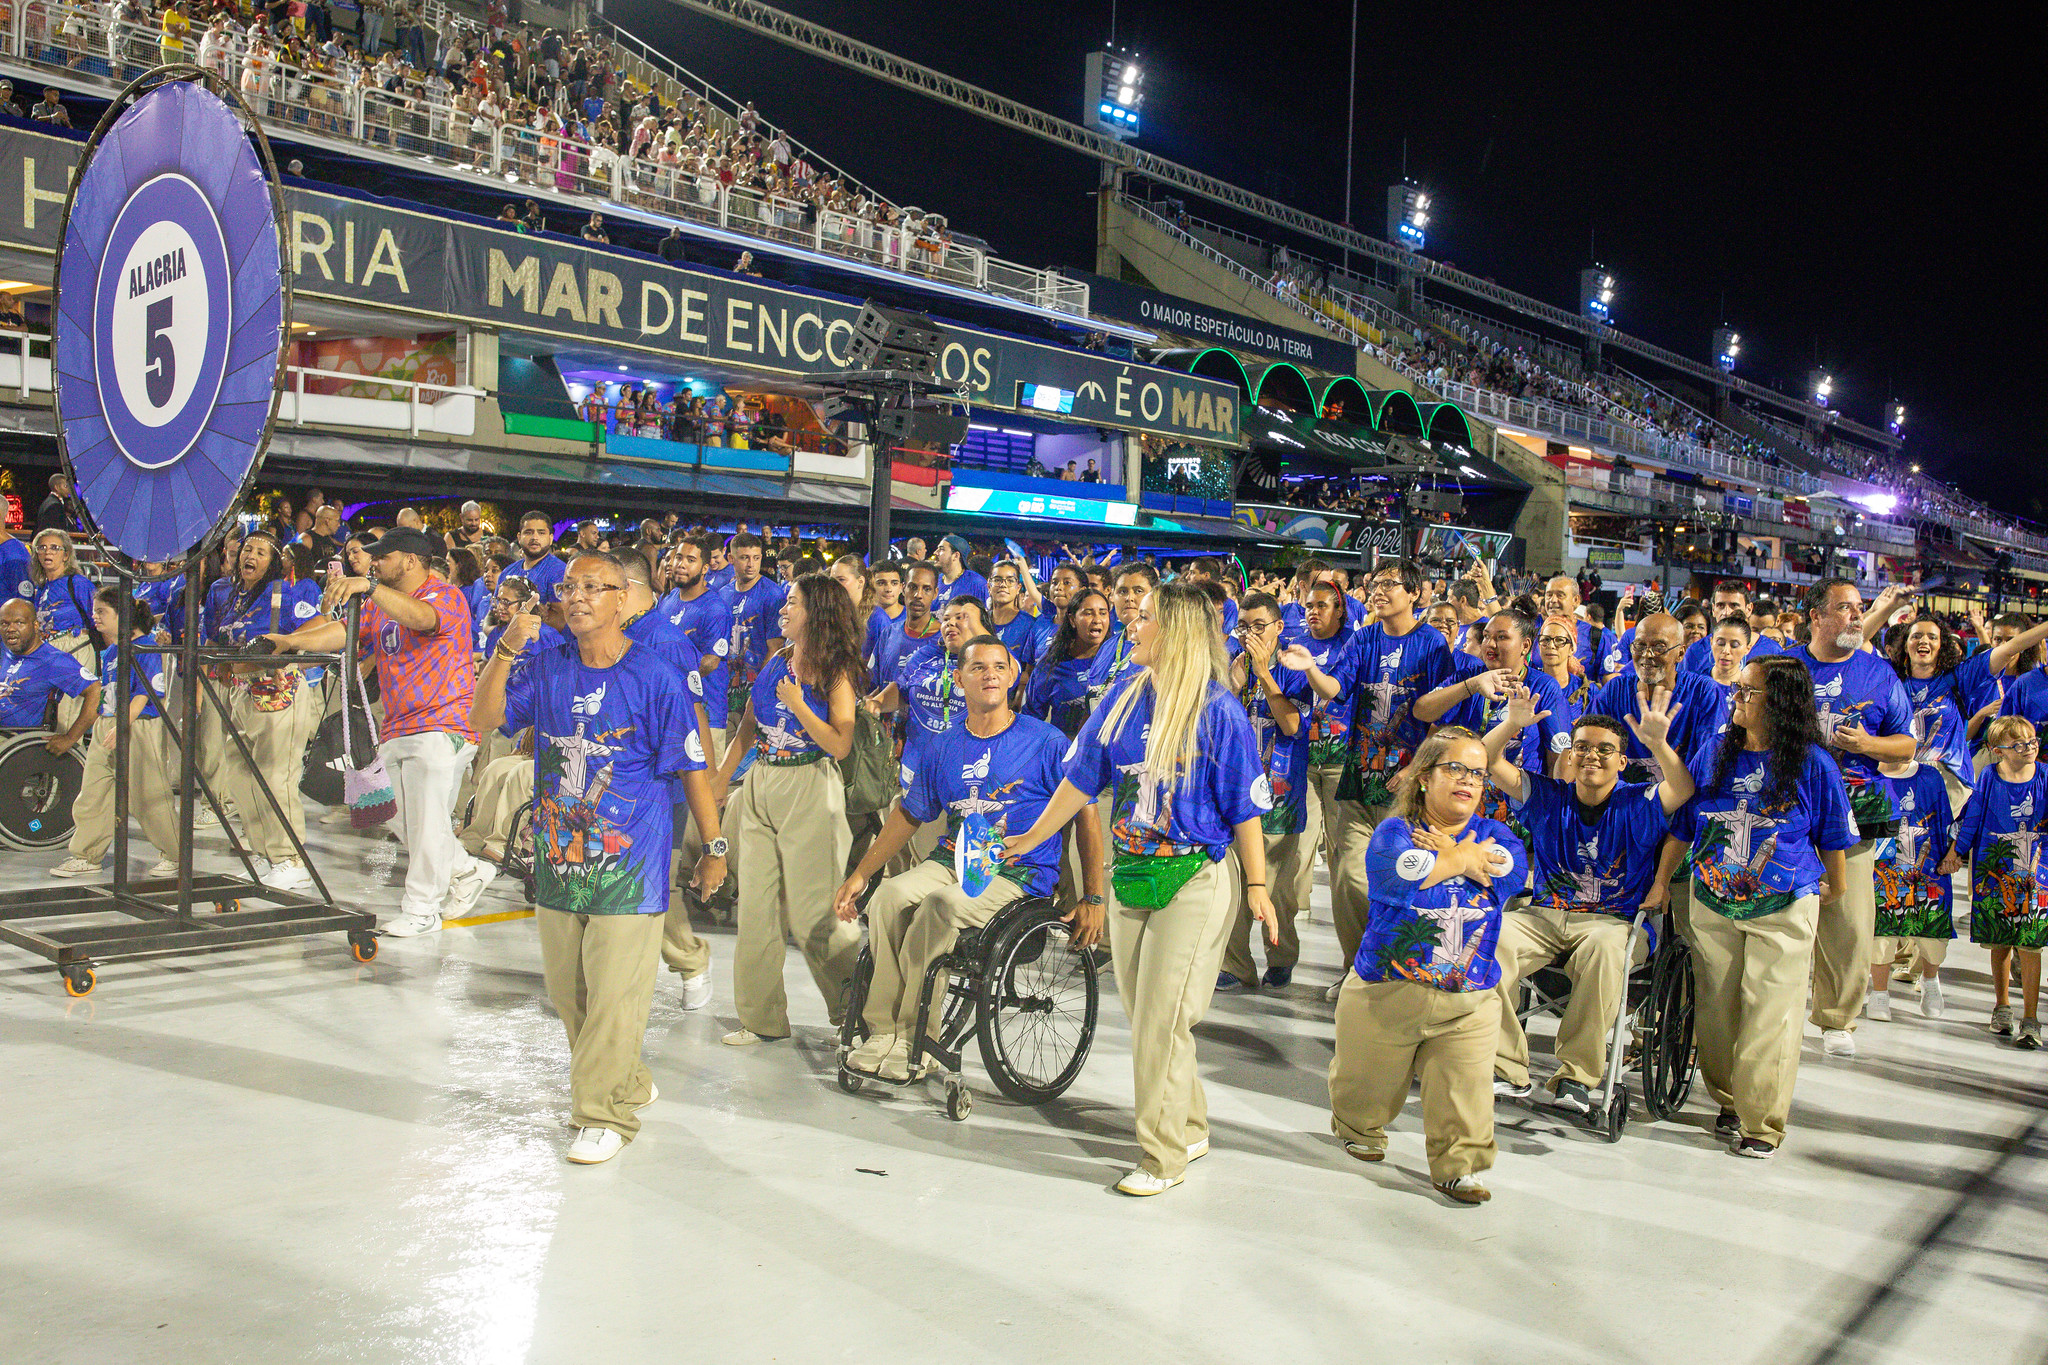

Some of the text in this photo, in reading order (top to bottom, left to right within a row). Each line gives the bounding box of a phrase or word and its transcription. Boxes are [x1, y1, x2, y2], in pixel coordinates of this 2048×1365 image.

[129, 247, 187, 300] ALAGRIA
[488, 247, 991, 391] MAR DE ENCOOS
[1140, 301, 1313, 360] O MAIOR ESPETÁCULO DA TERRA
[145, 295, 176, 408] 5
[1115, 366, 1133, 418] É
[1140, 381, 1163, 422] O
[1171, 387, 1234, 434] MAR
[916, 693, 966, 708] EMBAIXAORES
[930, 702, 958, 712] ALERIA
